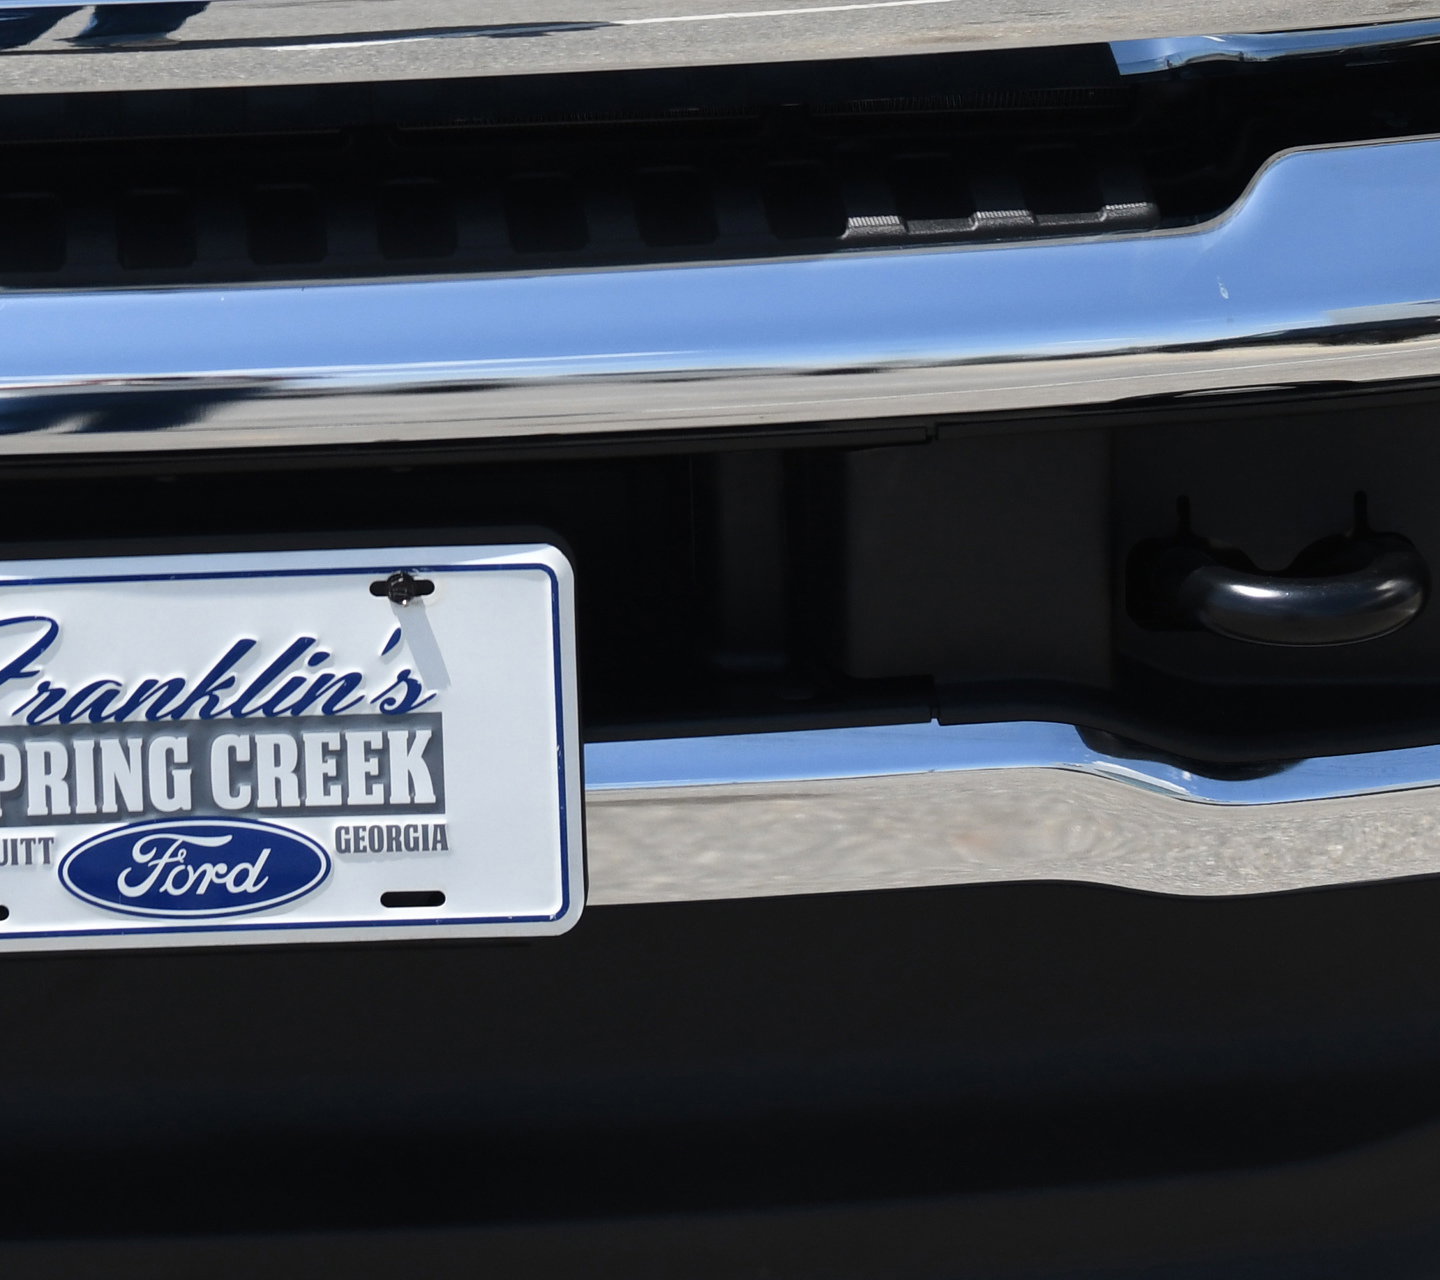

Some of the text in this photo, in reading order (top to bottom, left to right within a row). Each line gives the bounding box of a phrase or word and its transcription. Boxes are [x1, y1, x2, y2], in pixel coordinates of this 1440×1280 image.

[210, 728, 438, 814] CREEK
[117, 833, 270, 899] Ford
[334, 823, 450, 856] GEORGIA
